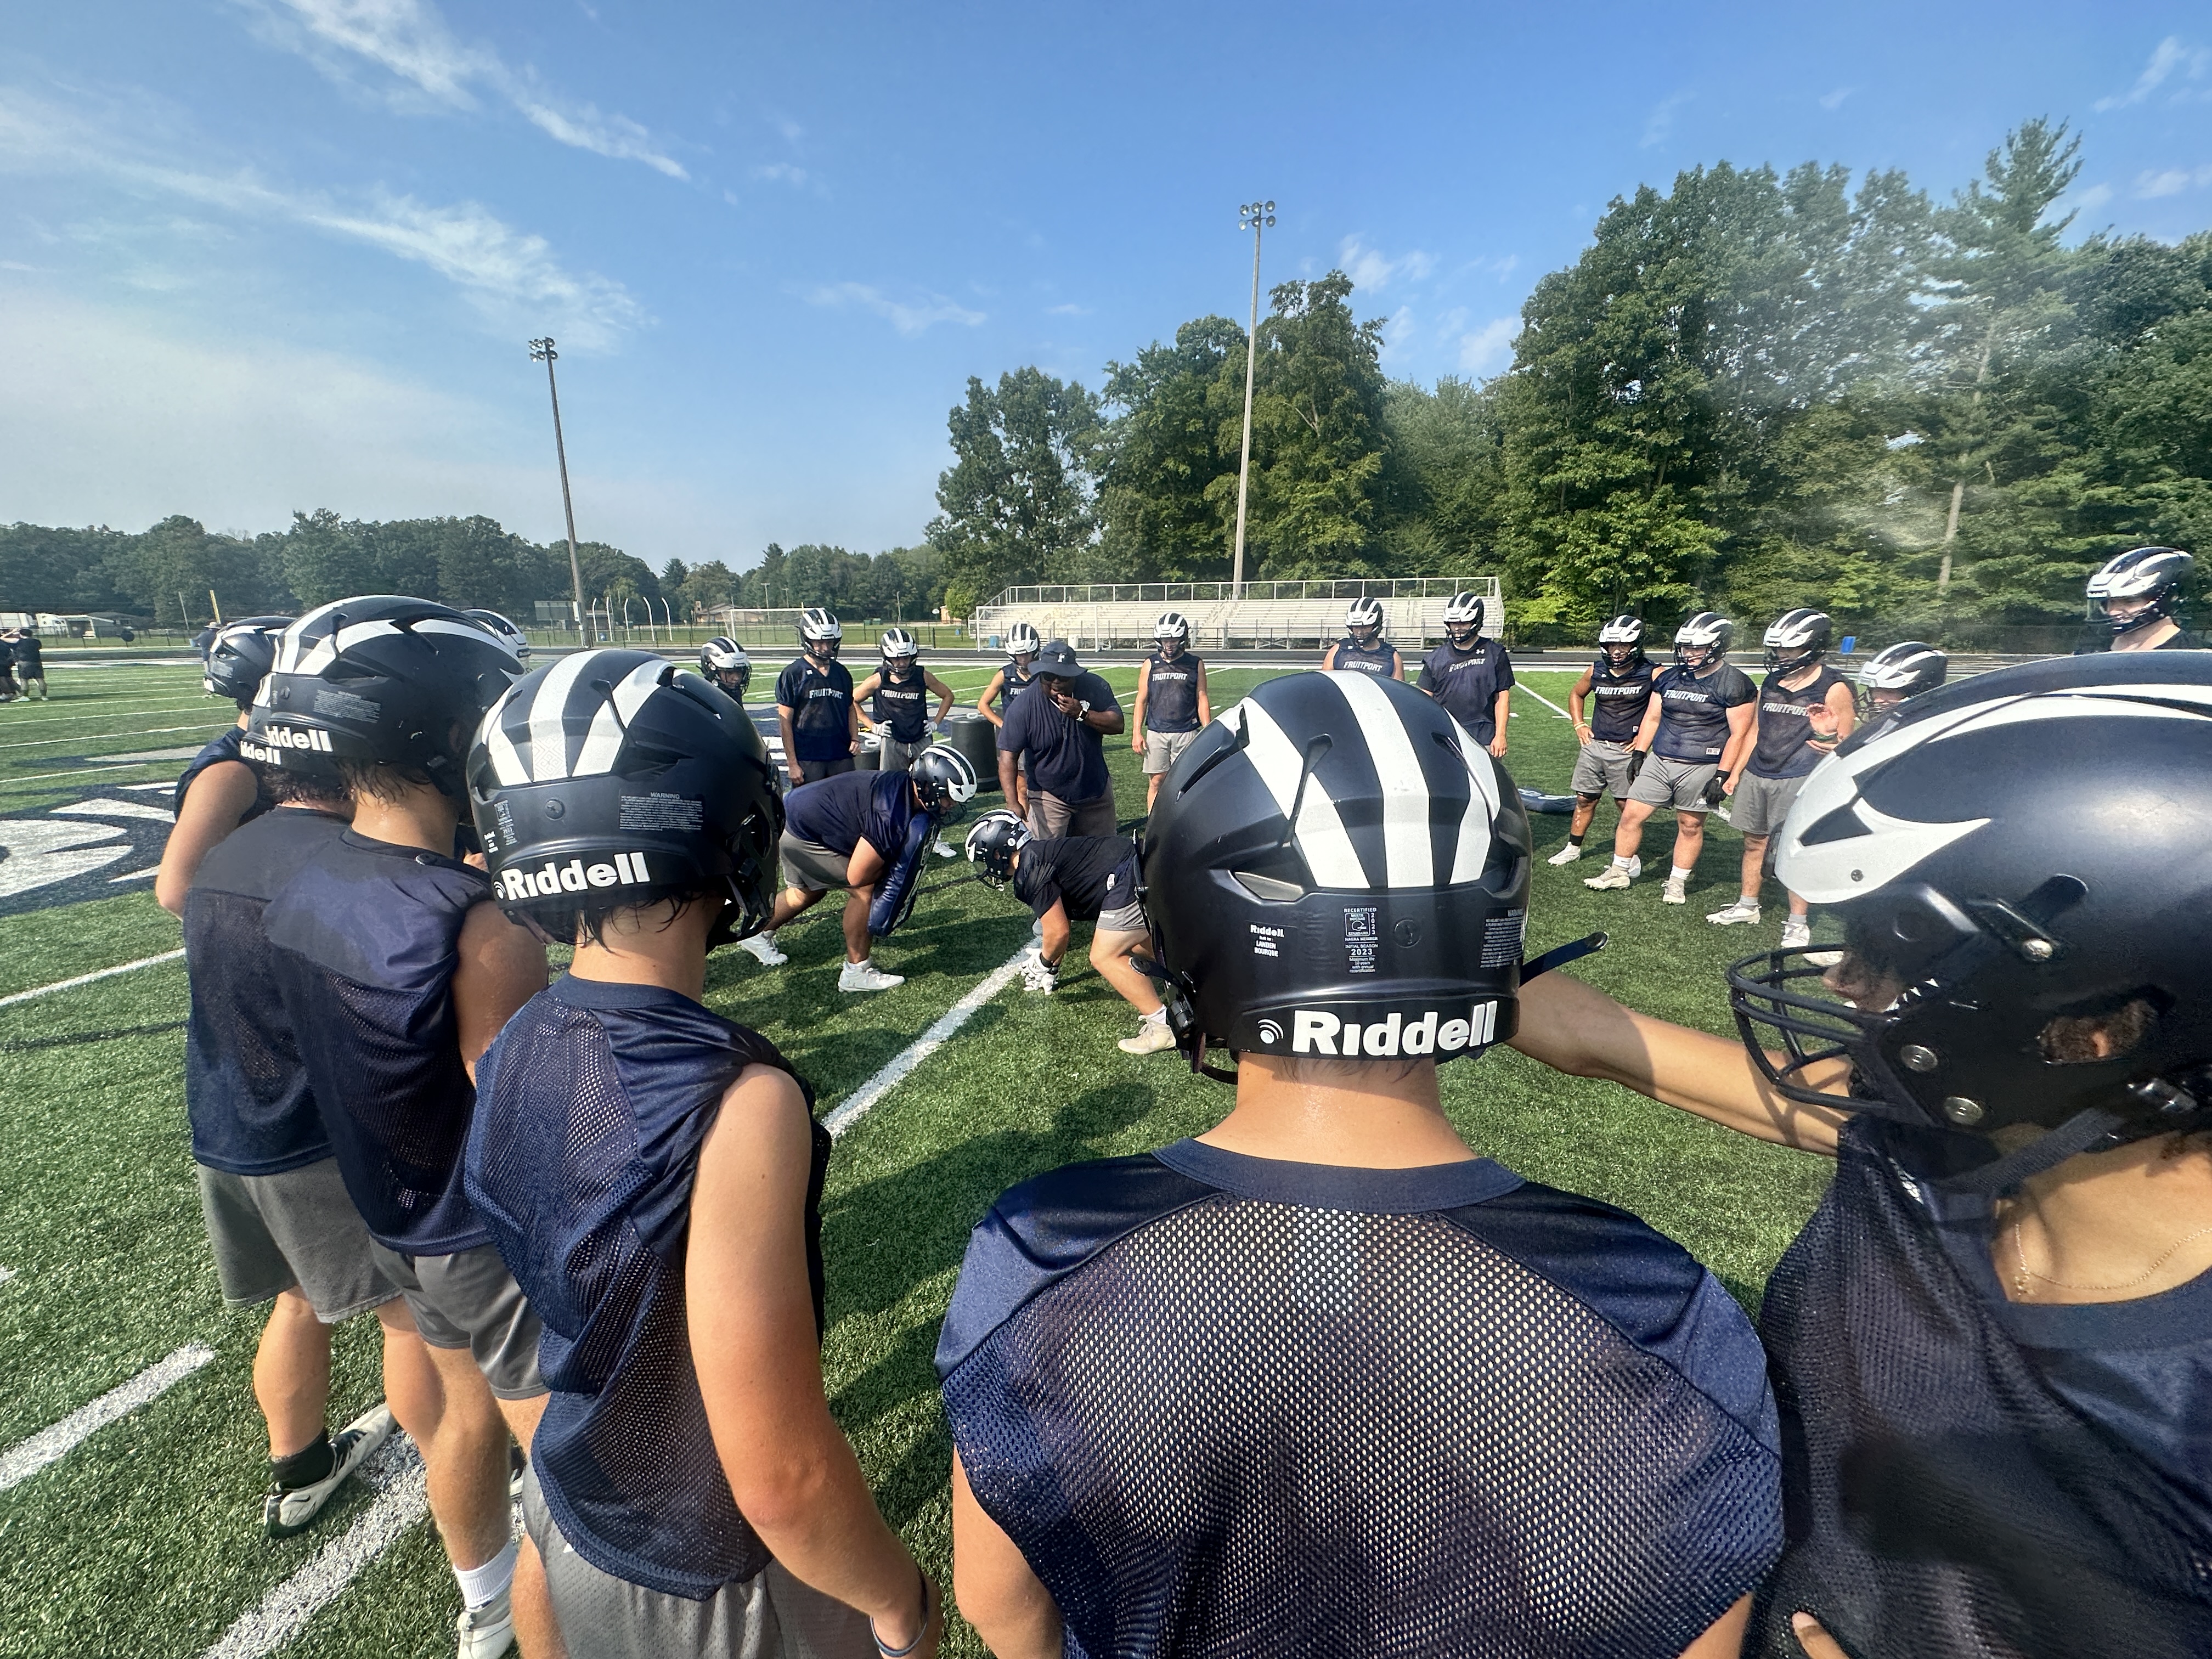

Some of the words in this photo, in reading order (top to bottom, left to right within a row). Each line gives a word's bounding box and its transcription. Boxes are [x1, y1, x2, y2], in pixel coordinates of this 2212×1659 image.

[1344, 661, 1383, 672] FRUITPORT
[1152, 673, 1188, 681] FRUITPORT
[881, 690, 919, 699] FRUITPORT
[1595, 686, 1642, 695] FRUITPORT
[1663, 690, 1709, 703] FRUITPORT
[1762, 702, 1808, 716] FRUITPOR
[501, 852, 650, 901] Riddell
[1250, 924, 1285, 938] Riddell
[1293, 1001, 1498, 1056] Riddell
